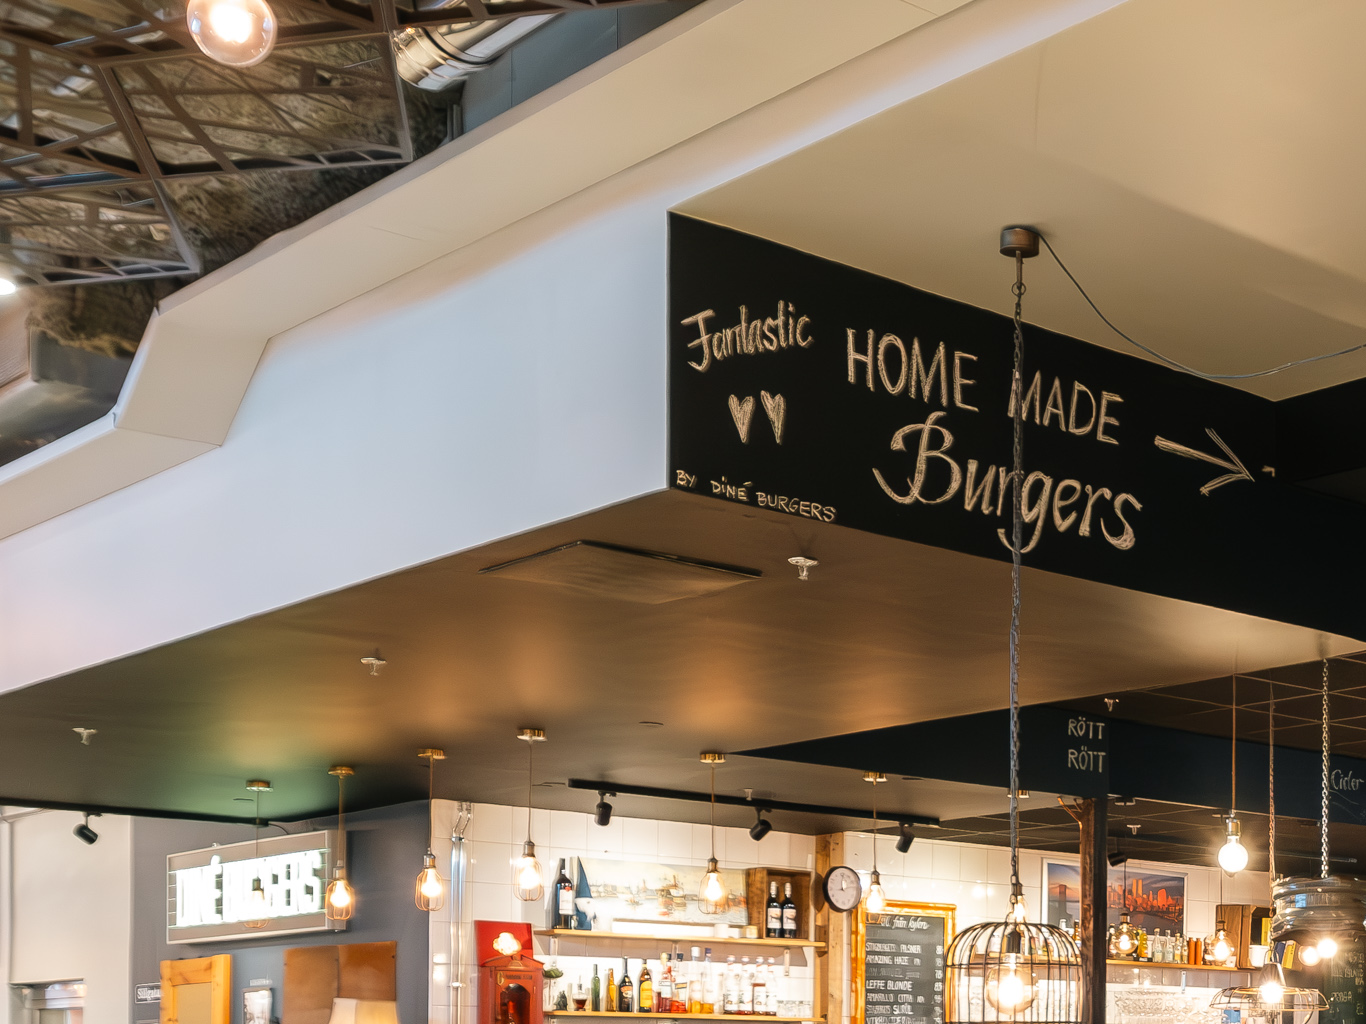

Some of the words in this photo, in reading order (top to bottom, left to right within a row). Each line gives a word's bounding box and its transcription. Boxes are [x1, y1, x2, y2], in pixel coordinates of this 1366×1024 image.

[680, 299, 814, 374] Fantastic
[845, 326, 980, 412] HOME
[1006, 369, 1124, 445] MADE
[676, 469, 697, 487] BY
[755, 491, 837, 523] BURGERS
[871, 410, 1143, 554] Burgers
[1067, 715, 1106, 740] RÖTT
[1067, 745, 1107, 773] RÖTT
[1330, 769, 1365, 791] Cider
[865, 955, 893, 966] AMAZING
[894, 956, 910, 966] HAZE
[866, 980, 885, 990] LEFFE
[887, 981, 913, 991] BLONDE
